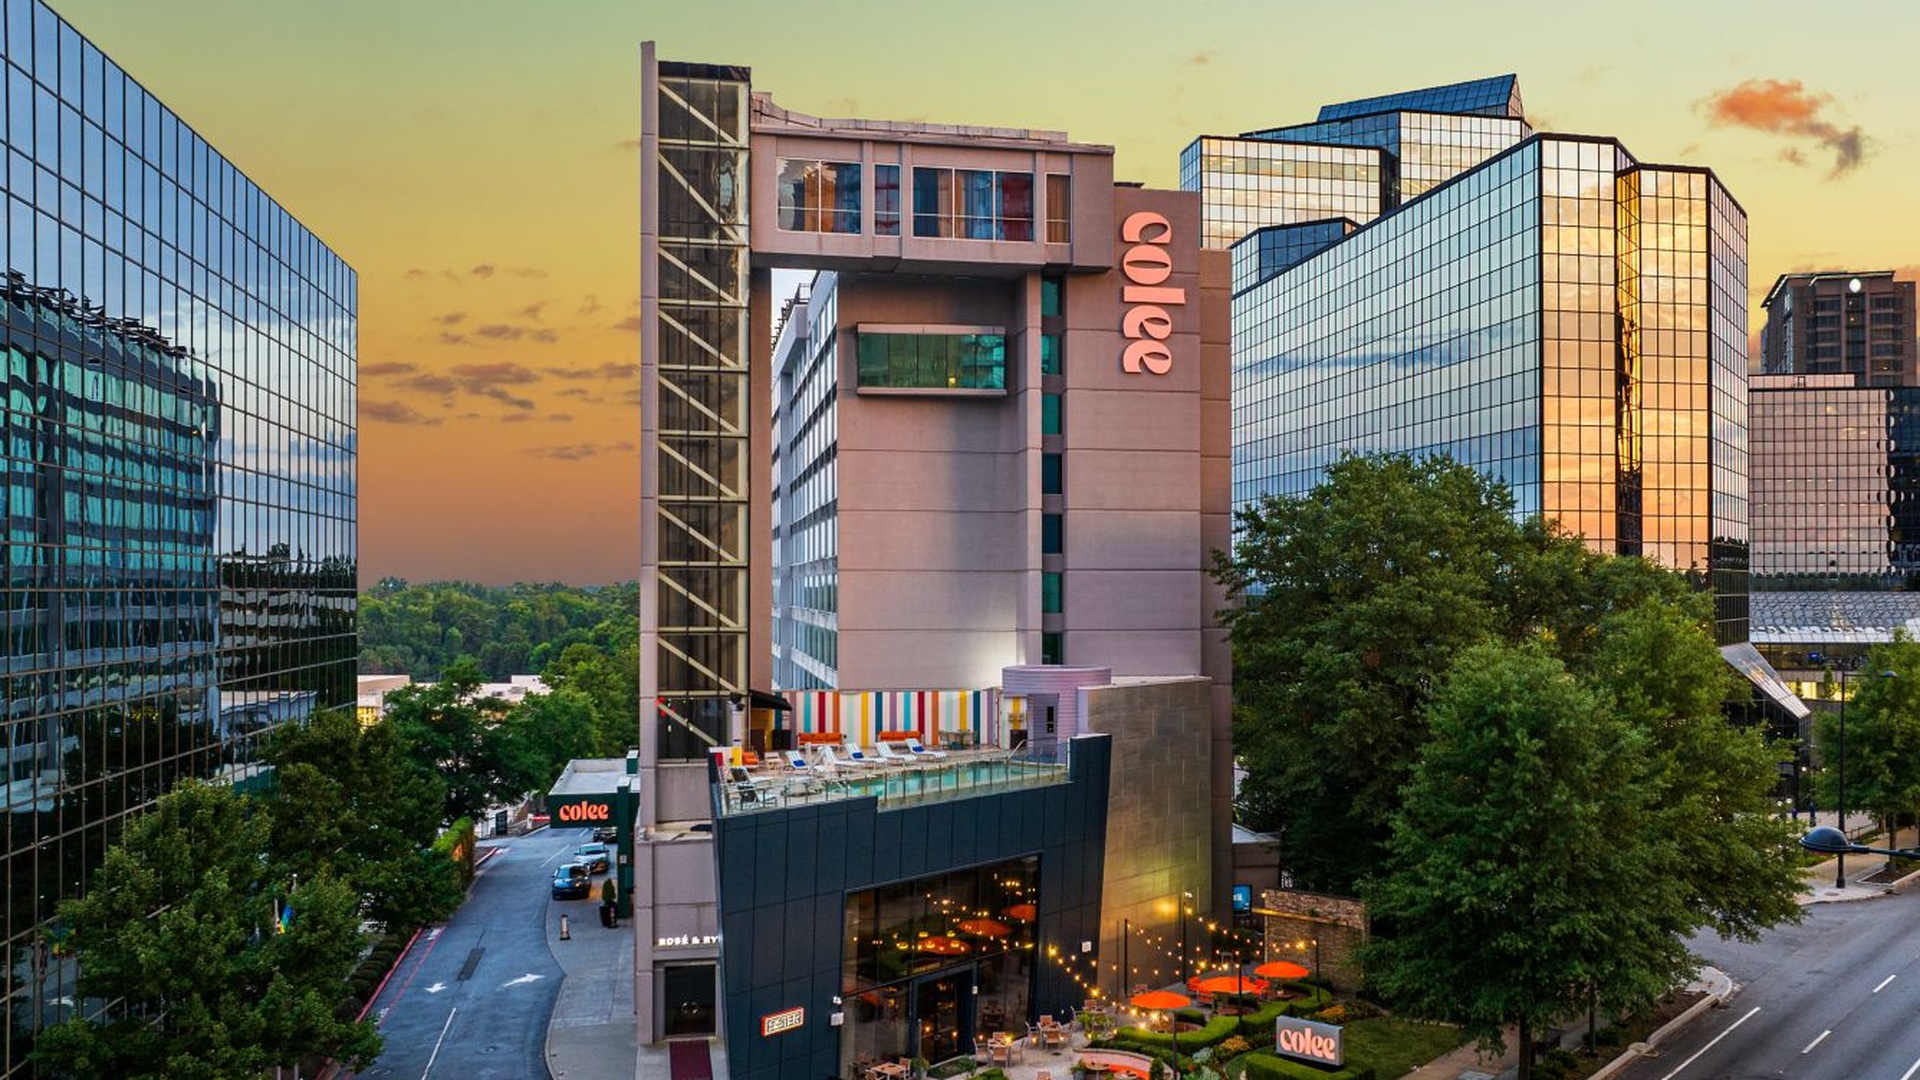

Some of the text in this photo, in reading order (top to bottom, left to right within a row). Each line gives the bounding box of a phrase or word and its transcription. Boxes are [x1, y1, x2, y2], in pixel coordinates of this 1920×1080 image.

[1122, 211, 1186, 375] colee
[559, 800, 609, 821] colee
[691, 936, 700, 945] &
[1280, 1027, 1336, 1060] colee
